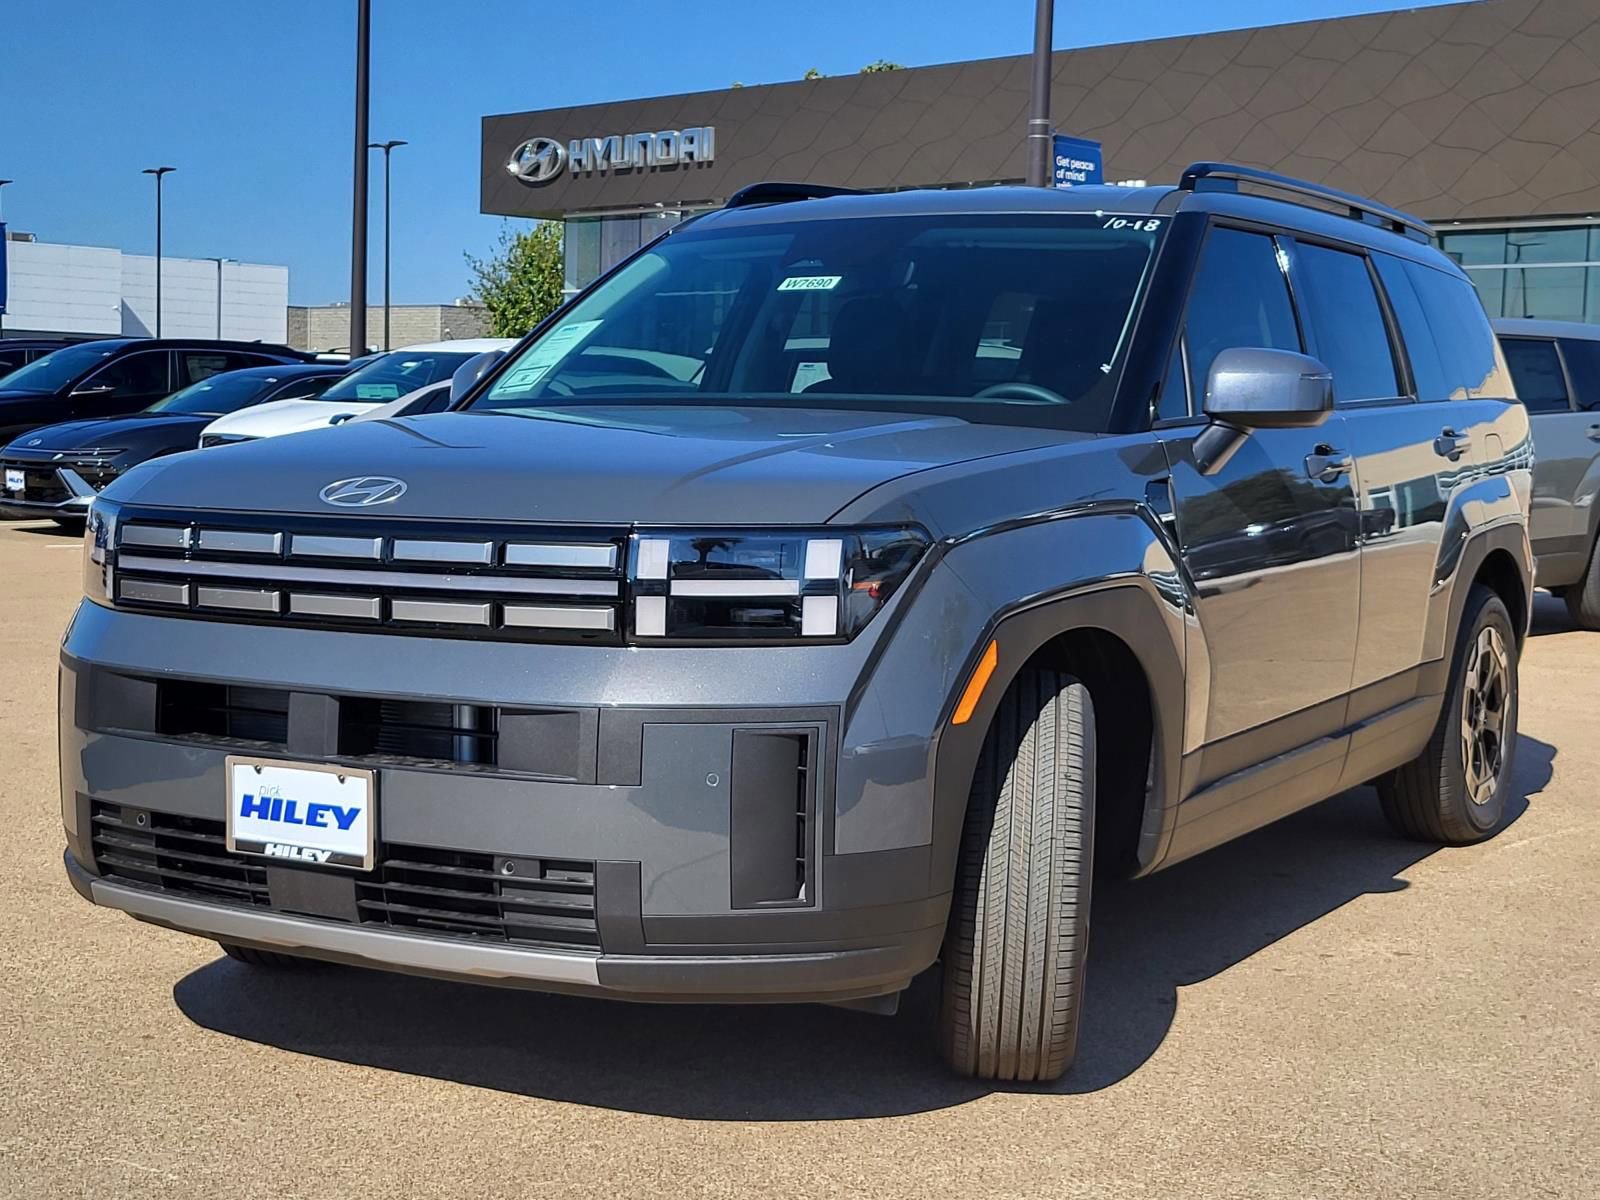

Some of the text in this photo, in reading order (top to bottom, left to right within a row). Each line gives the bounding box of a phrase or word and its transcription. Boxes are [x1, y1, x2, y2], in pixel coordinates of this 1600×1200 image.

[569, 126, 715, 173] HYUNDAI
[1056, 156, 1095, 171] Get peace
[1056, 169, 1086, 182] of mind
[1103, 217, 1160, 232] 10-18
[785, 279, 833, 288] W7690
[240, 794, 361, 830] HILEY
[264, 843, 332, 863] HILEY
